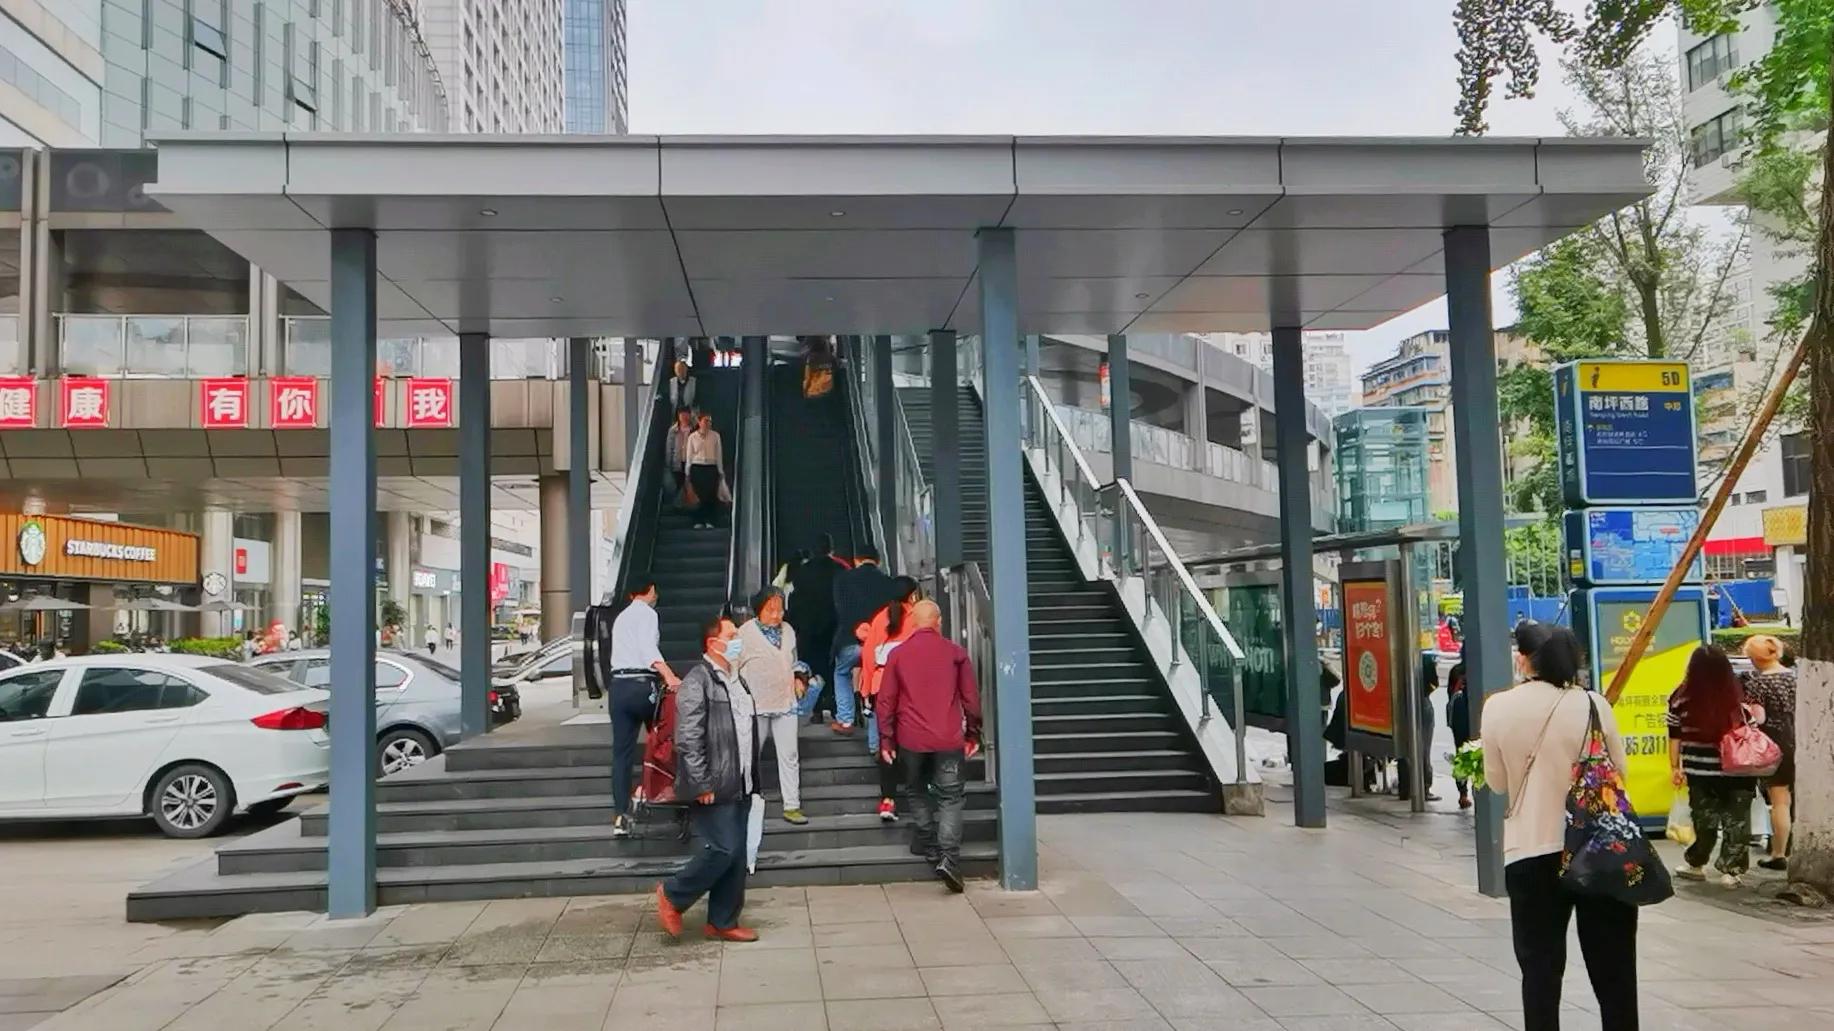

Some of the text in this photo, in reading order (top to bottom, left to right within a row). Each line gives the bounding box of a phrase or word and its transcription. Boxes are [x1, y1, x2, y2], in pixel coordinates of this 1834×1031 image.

[0, 387, 104, 420] 健康
[66, 539, 156, 562] STARBUCKS COFFEE
